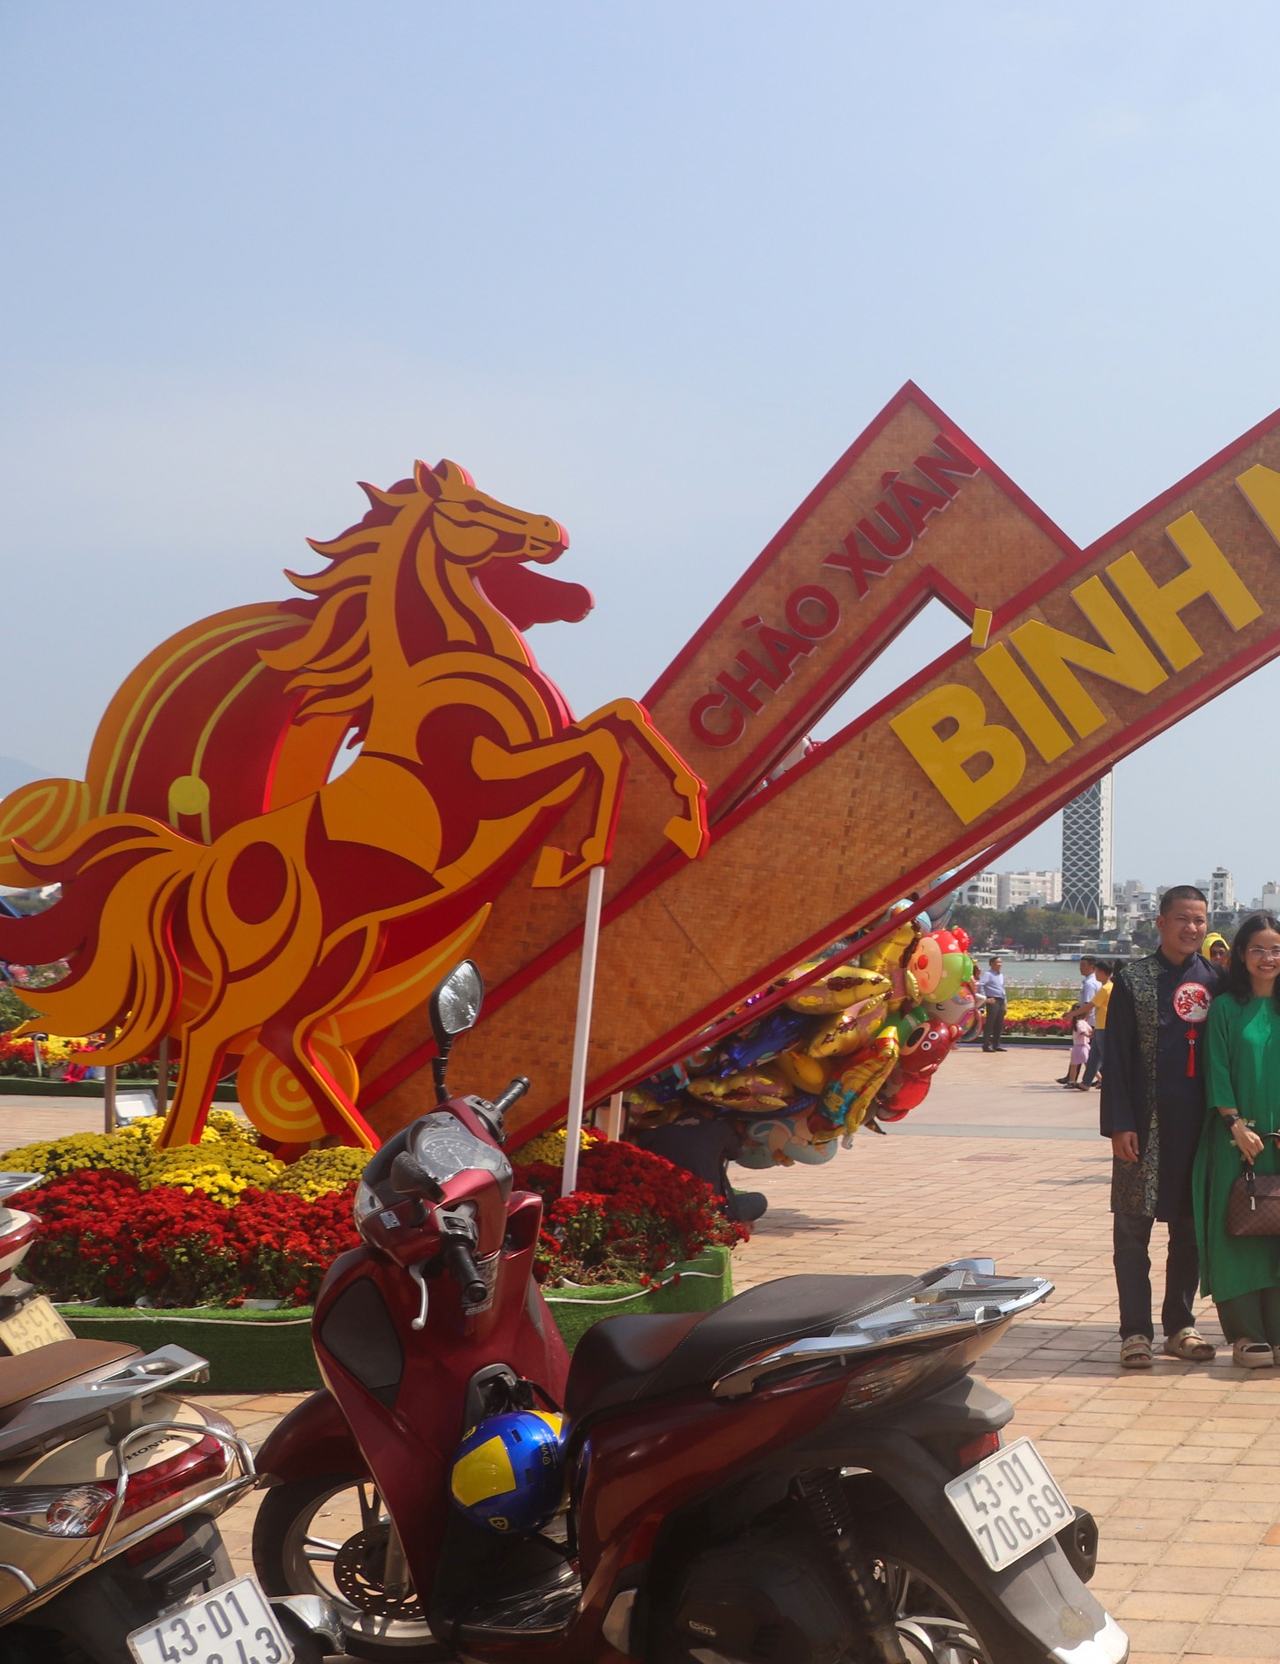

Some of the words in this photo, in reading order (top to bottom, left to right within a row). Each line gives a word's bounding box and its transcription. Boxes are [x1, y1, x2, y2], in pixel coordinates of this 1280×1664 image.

[689, 584, 841, 748] CHÀO
[822, 432, 981, 602] XUÂN
[888, 510, 1264, 826] BÍNH
[125, 1434, 181, 1460] HONDA
[963, 1452, 1035, 1516] 43-D1
[975, 1484, 1066, 1563] 706.69
[154, 1590, 250, 1664] 43-D1
